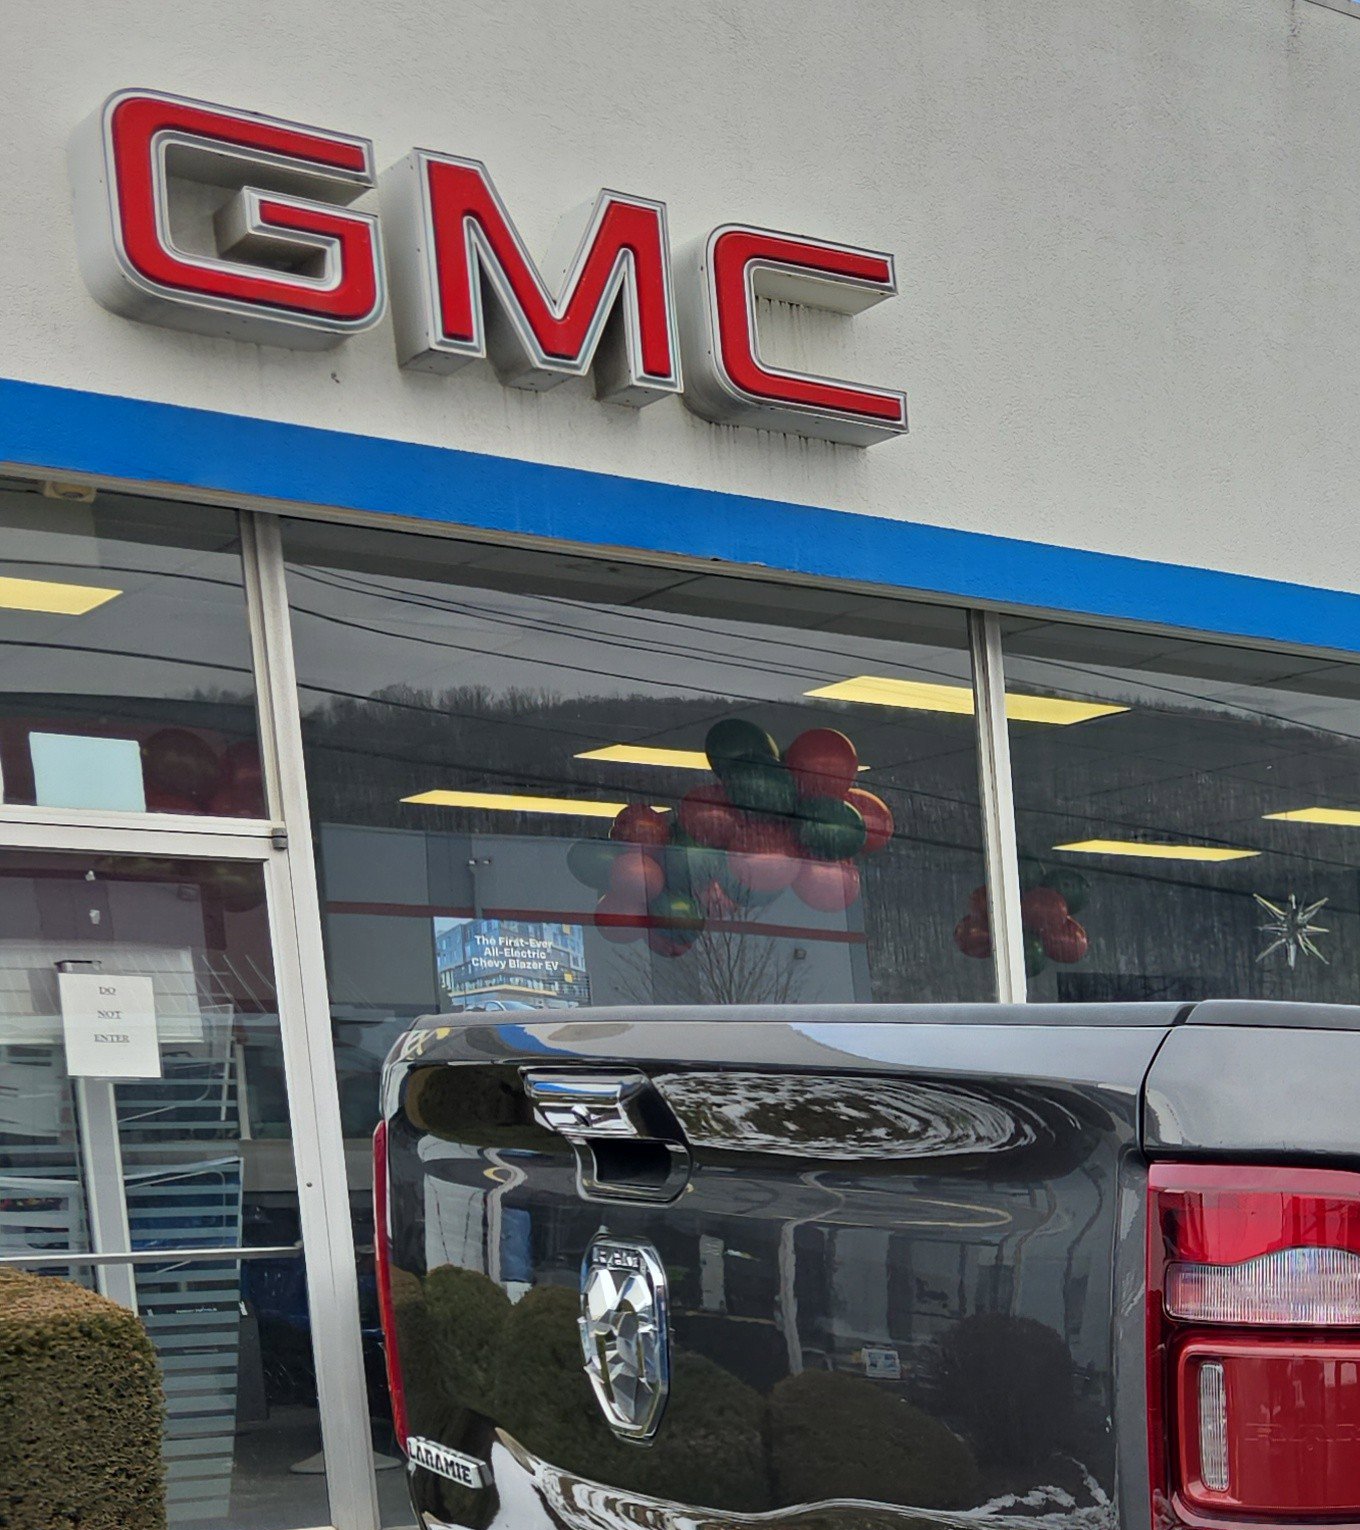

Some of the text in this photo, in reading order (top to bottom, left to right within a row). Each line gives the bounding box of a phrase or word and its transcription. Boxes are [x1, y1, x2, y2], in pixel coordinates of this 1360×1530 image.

[100, 86, 909, 438] GMC
[474, 935, 553, 949] The First-Ever
[484, 947, 547, 959] All-Electric
[471, 957, 560, 971] Chevy Blazer EV
[99, 986, 117, 996] DO
[97, 1010, 122, 1020] NOT
[94, 1034, 130, 1043] ENTER
[406, 1438, 476, 1487] LARAMIE
